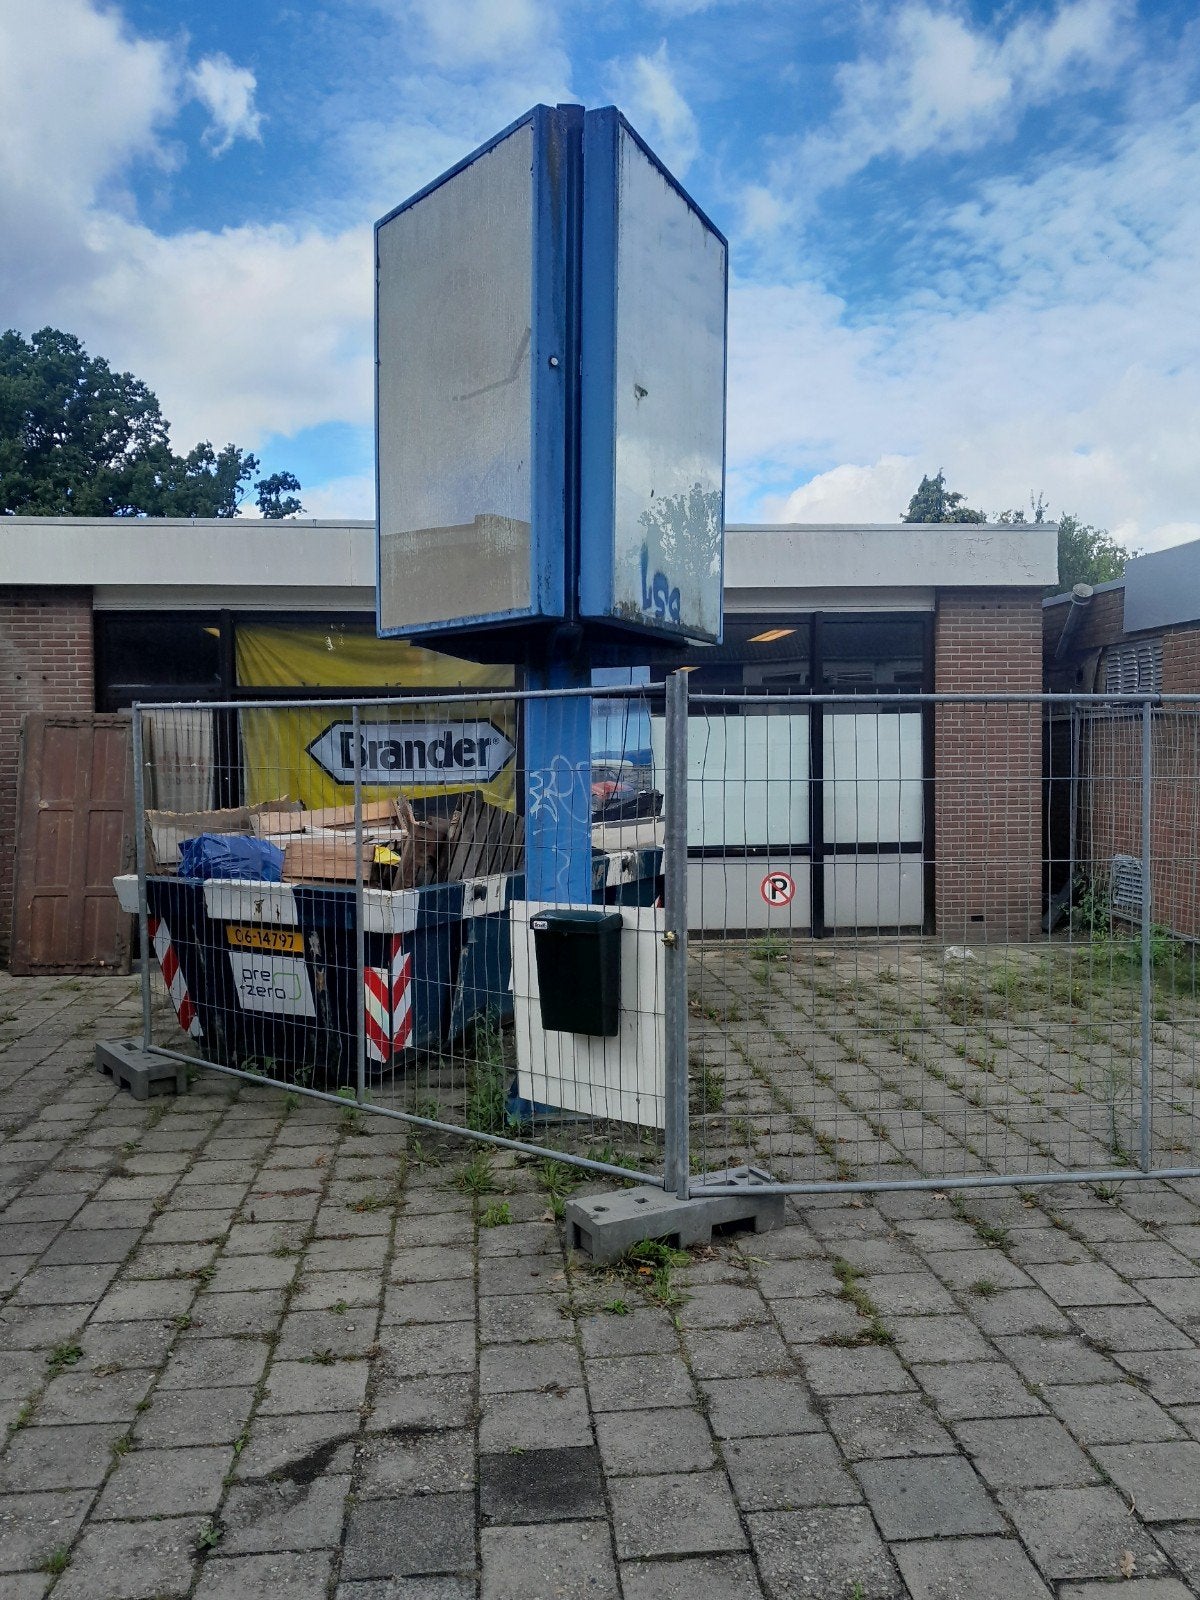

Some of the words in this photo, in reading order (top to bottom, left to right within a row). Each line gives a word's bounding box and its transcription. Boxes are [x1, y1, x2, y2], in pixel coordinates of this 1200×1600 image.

[340, 731, 489, 769] Brander
[771, 878, 788, 900] P
[242, 968, 271, 982] pre
[246, 984, 286, 1000] zero
